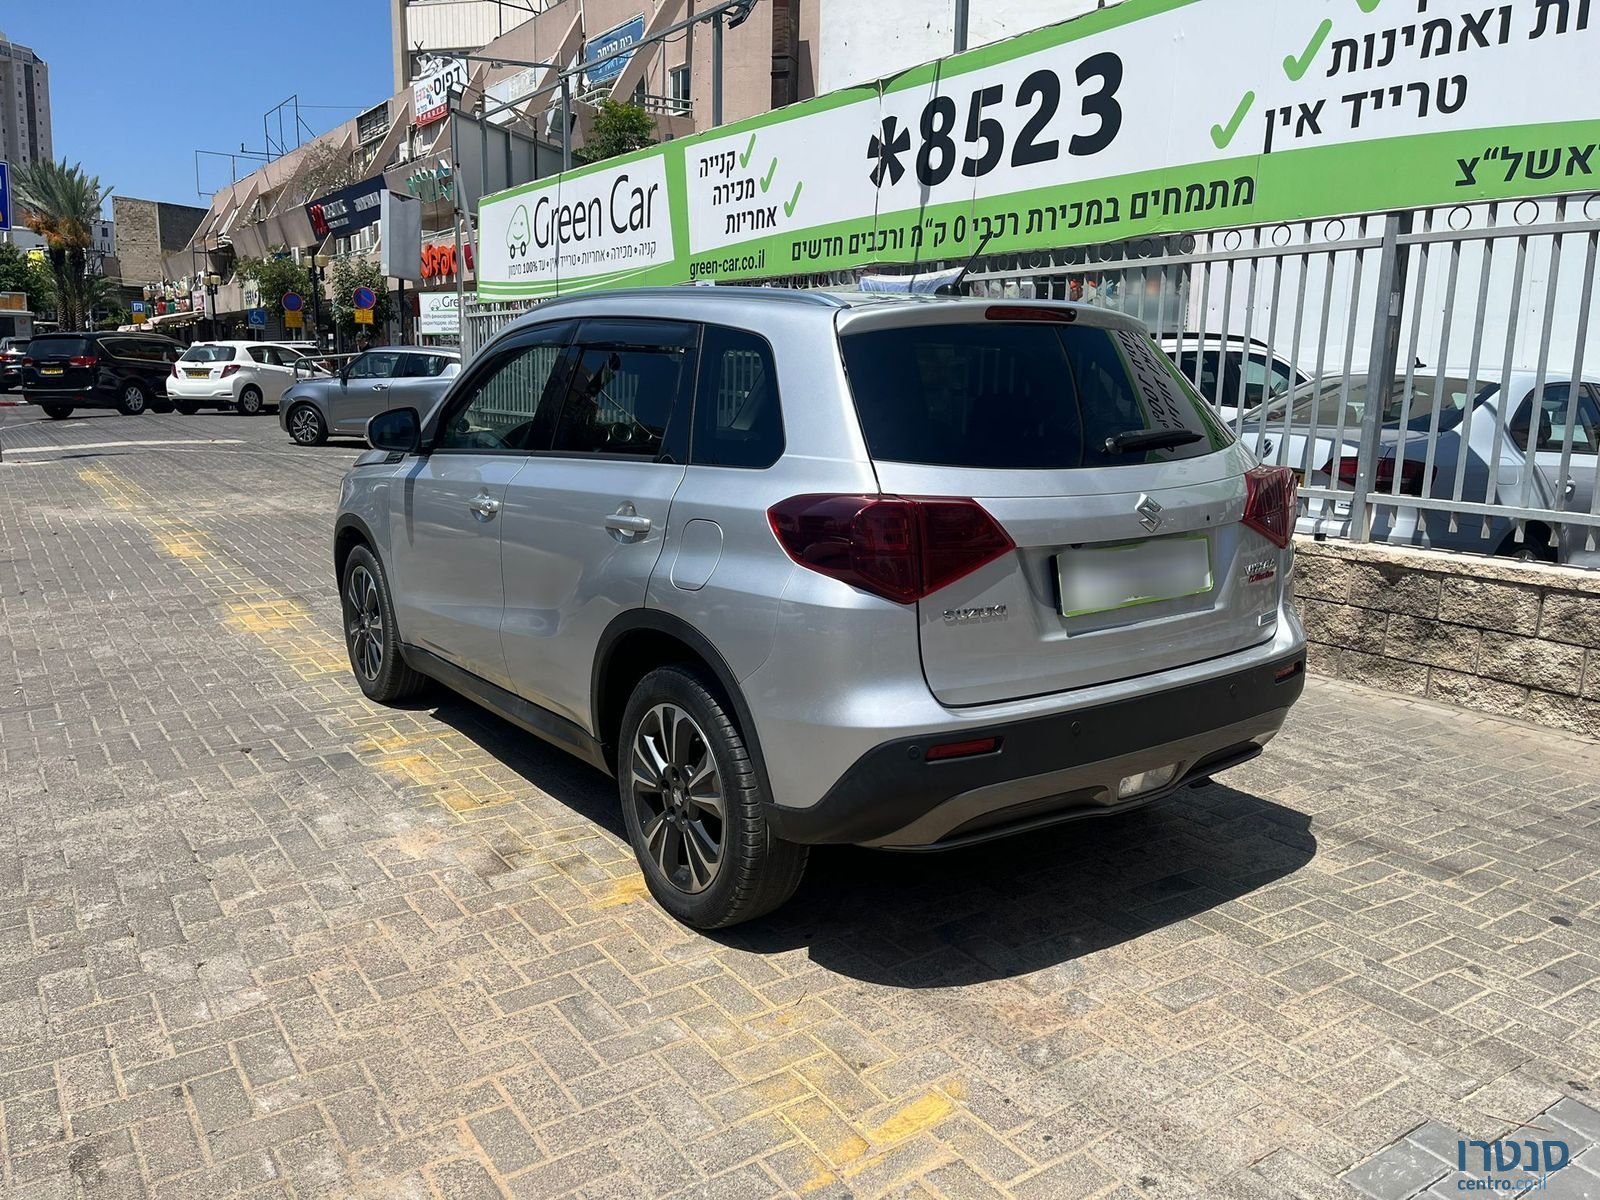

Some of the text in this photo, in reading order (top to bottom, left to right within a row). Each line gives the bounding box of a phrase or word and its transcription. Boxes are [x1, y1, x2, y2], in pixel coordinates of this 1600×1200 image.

[1326, 4, 1513, 78] ואמינות
[433, 65, 461, 96] דפוס
[1263, 74, 1469, 154] טרייד אין
[699, 150, 736, 178] קנייה
[1455, 143, 1600, 187] אשל"צ
[713, 177, 755, 206] מכירה
[1129, 175, 1255, 220] מתמחים
[533, 174, 658, 249] Green Car
[725, 206, 777, 235] אחריות
[1025, 196, 1121, 234] במכירת
[849, 227, 905, 255] ורכבים
[953, 215, 966, 243] 0
[972, 212, 1020, 242] רכבי
[560, 254, 577, 267] טרייד
[581, 249, 606, 265] אחריות
[610, 245, 633, 261] מכירה
[639, 241, 657, 259] קניה
[791, 236, 844, 262] חדשים
[522, 261, 538, 274] 100%
[538, 260, 546, 271] עד
[689, 249, 765, 280] green-car.co.il
[942, 604, 1007, 621] SUZUKI
